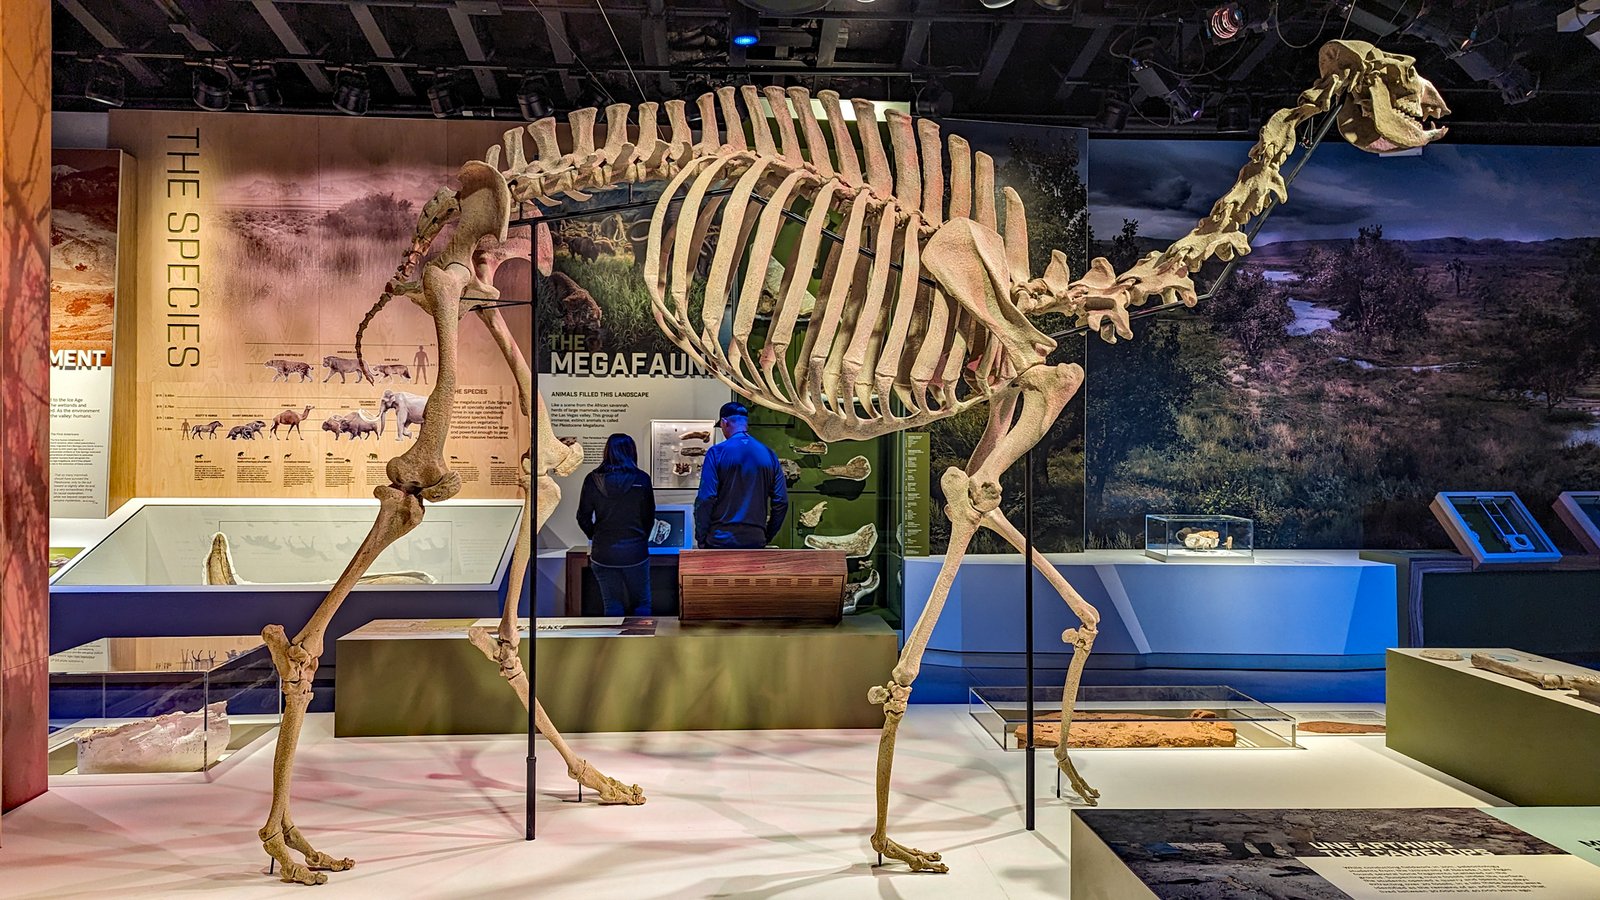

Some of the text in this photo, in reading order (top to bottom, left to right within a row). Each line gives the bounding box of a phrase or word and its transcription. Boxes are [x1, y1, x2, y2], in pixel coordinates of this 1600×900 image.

[167, 128, 200, 198] THE
[167, 212, 200, 367] SPECIES
[550, 334, 586, 350] THE
[551, 352, 728, 376] MEGAFAUN
